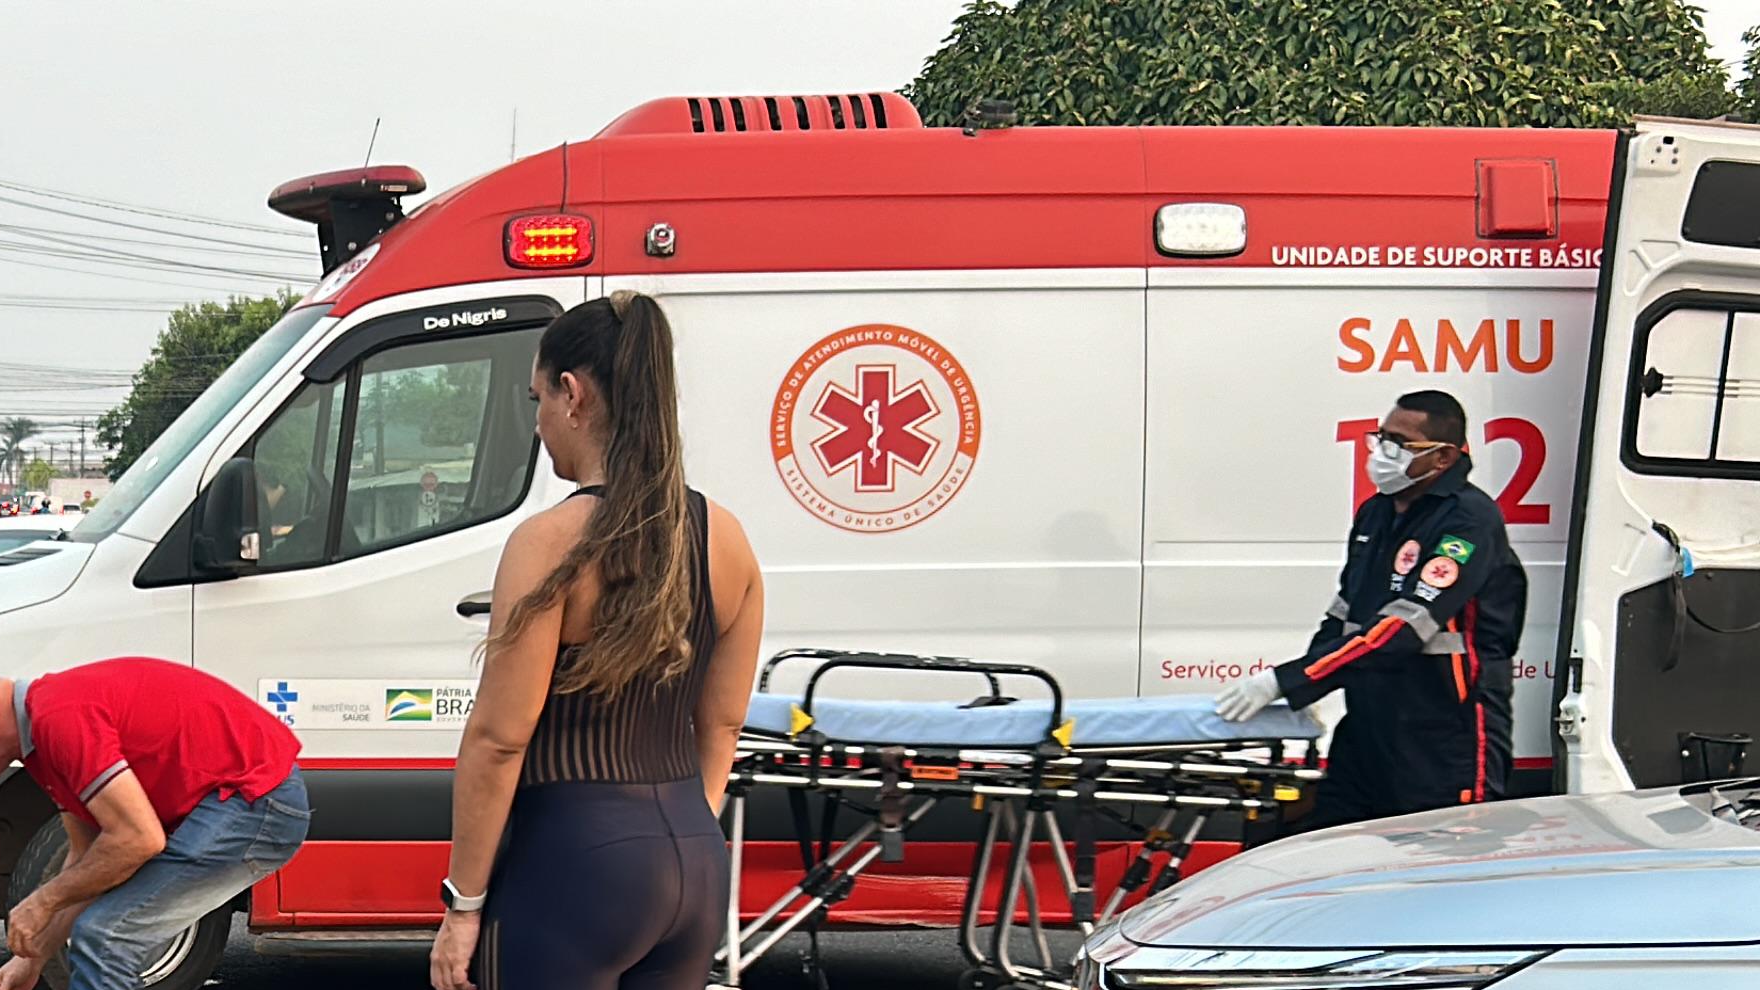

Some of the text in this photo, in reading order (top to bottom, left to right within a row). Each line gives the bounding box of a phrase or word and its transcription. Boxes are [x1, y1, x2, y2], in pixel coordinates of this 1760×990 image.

[1271, 246, 1381, 267] UNIDADE
[1386, 247, 1417, 267] DE
[1423, 247, 1533, 267] SUPORTE
[424, 307, 507, 331] De Nigris
[1336, 317, 1554, 374] SAMU
[776, 330, 975, 448] SERVIÇO DE ATENDIMENTO MÓVEL DE URGÊNCIA
[1335, 417, 1551, 525] 12
[787, 467, 964, 527] SISTEMA ÚNICO DE SAÚDE
[1161, 659, 1242, 683] Serviço
[1511, 659, 1537, 679] de
[436, 686, 472, 698] PÁTRIA
